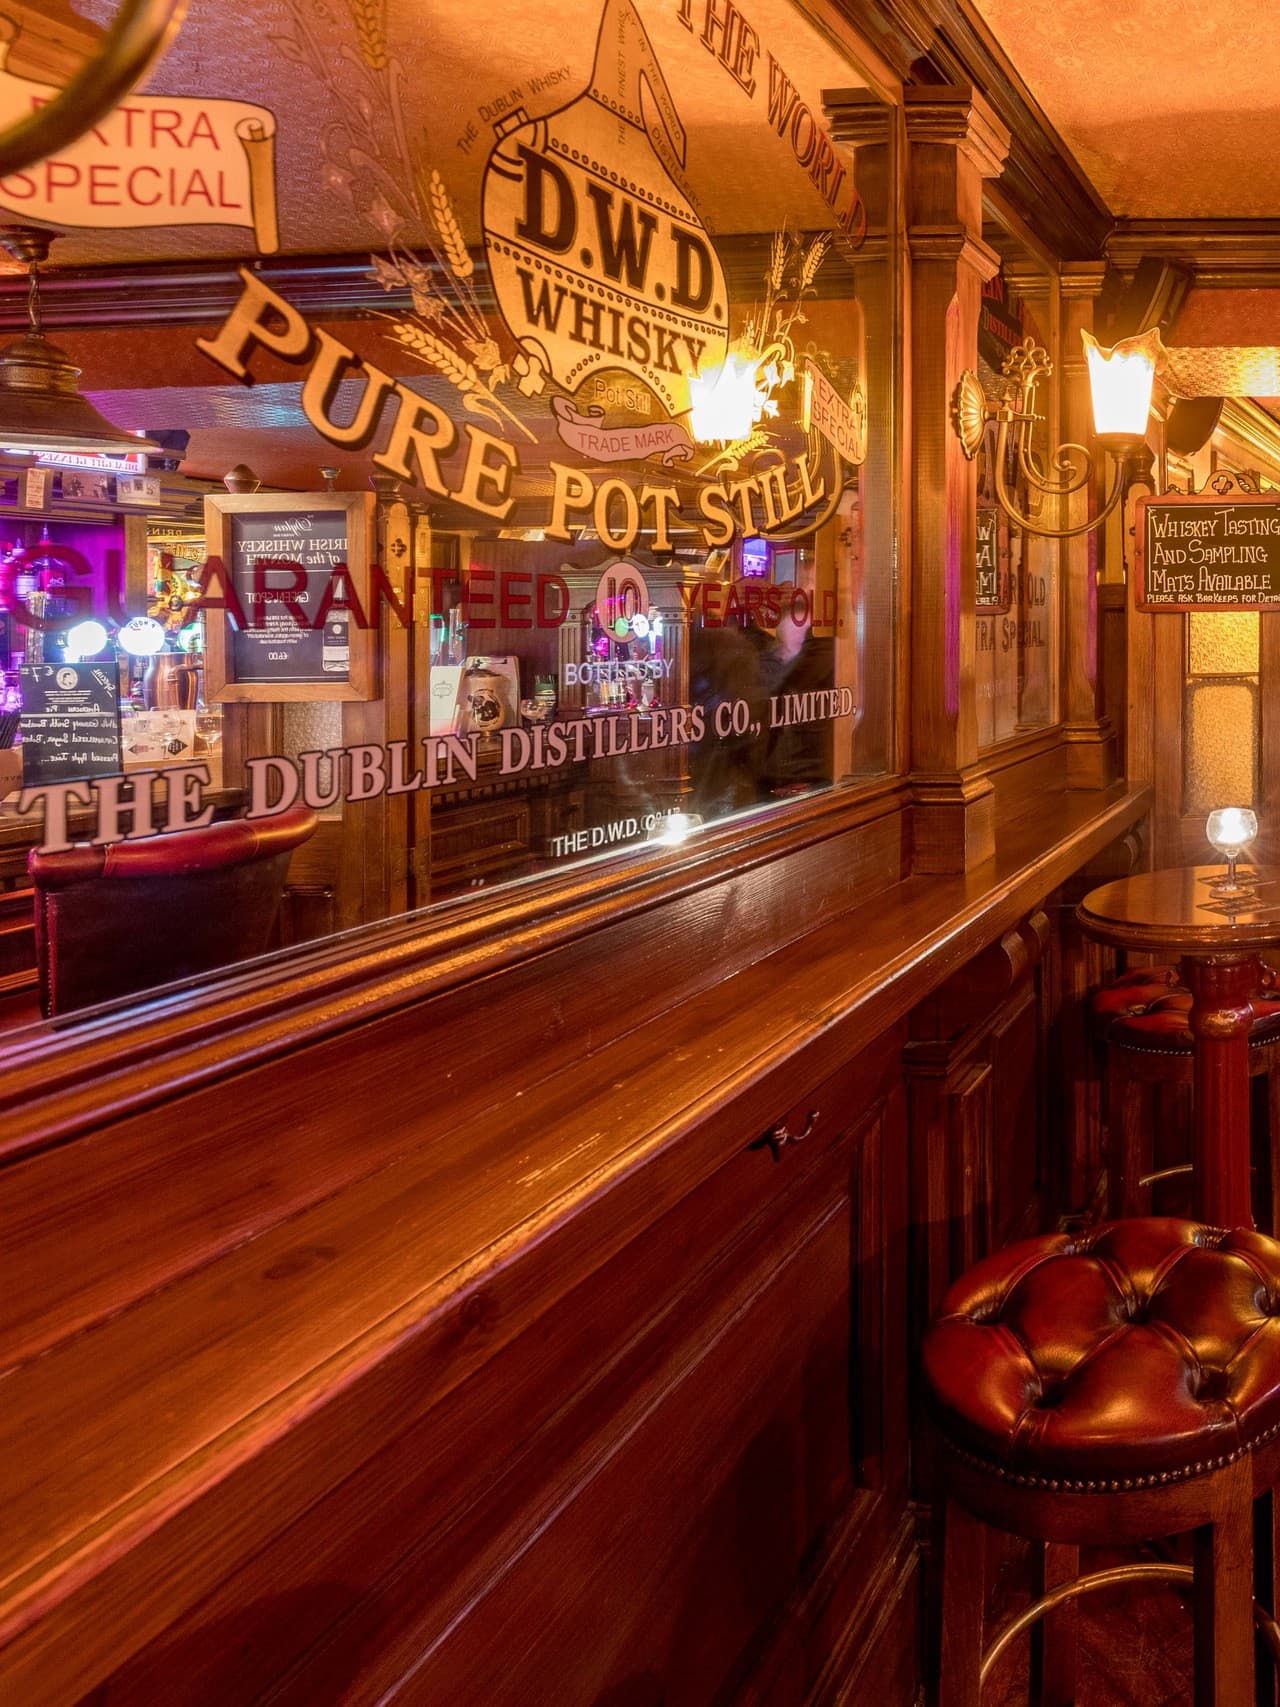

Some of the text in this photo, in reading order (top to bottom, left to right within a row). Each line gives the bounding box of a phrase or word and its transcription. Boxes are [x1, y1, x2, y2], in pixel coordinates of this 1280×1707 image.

[617, 50, 626, 98] FINEST
[456, 121, 480, 155] THE
[477, 87, 525, 123] DUBLIN
[527, 65, 571, 95] WHISKY
[766, 48, 868, 250] WORLD
[0, 159, 243, 210] SPECIAL
[515, 266, 709, 381] WHISKY
[195, 265, 826, 552] PURE POT STILL
[594, 378, 620, 406] Pot
[577, 428, 675, 454] TRADE MARK
[813, 378, 862, 461] EXTRA SPECIAL
[1151, 513, 1219, 538] WHISKEY
[1153, 539, 1269, 566] AND SAMPLING
[9, 544, 571, 633] GUARANTEED
[606, 576, 642, 631] 10
[677, 582, 783, 629] YEARS
[790, 587, 844, 628] OLD.
[1146, 594, 1174, 604] PLEASE
[1178, 594, 1194, 604] ASK
[1241, 594, 1256, 604] FOR
[1151, 566, 1272, 593] MATS AVAILABLE
[564, 657, 675, 686] BOTTLED BY
[17, 686, 857, 856] THE DUBLIN DISTILLERS CO., LIMITED.
[552, 830, 589, 858] THE
[591, 818, 641, 848] D.W.D.
